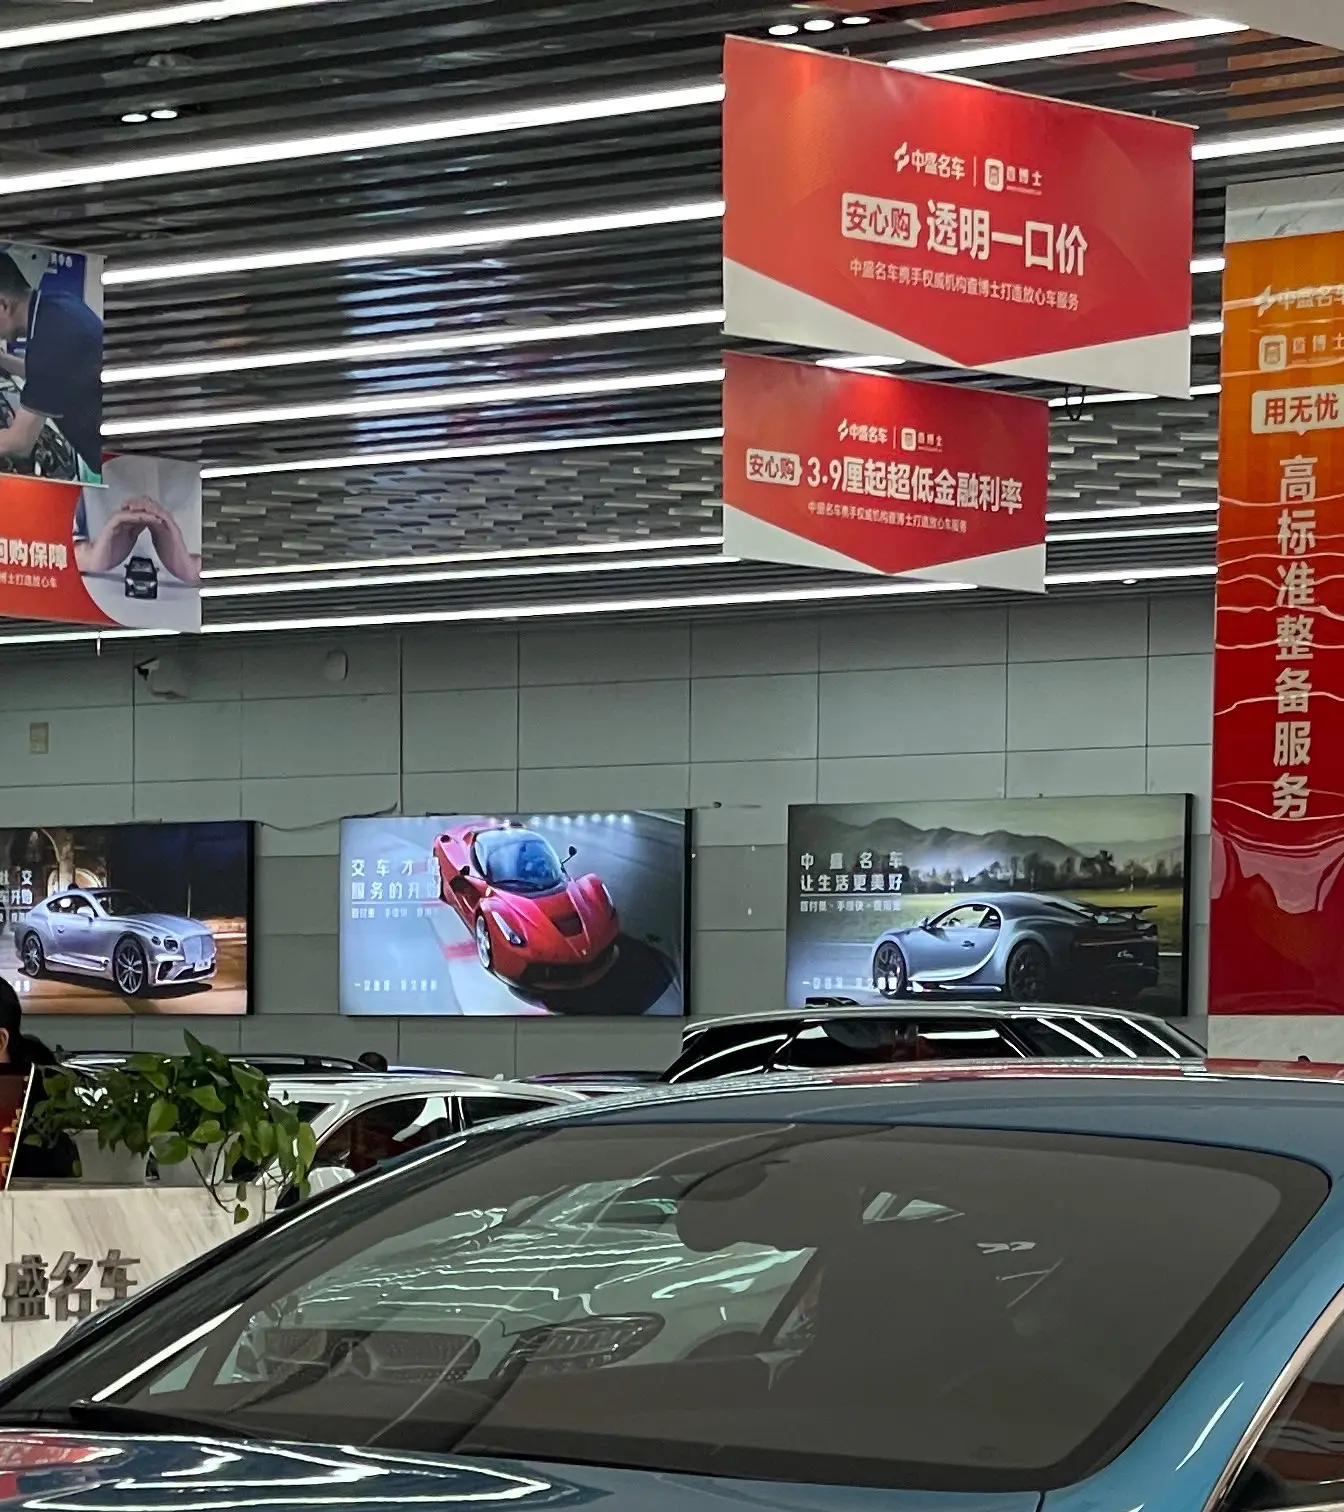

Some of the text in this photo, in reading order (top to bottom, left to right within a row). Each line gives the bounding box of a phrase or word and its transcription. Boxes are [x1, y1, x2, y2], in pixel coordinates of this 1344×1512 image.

[911, 149, 966, 180] 中盛名车
[846, 199, 1088, 276] 安心购 透明一口价
[1263, 392, 1340, 427] 用无忧
[749, 453, 1024, 515] 安心购 3.9厘起超低金融利率
[1272, 454, 1319, 820] 高标准整备服务
[800, 872, 903, 892] 让生活更美好
